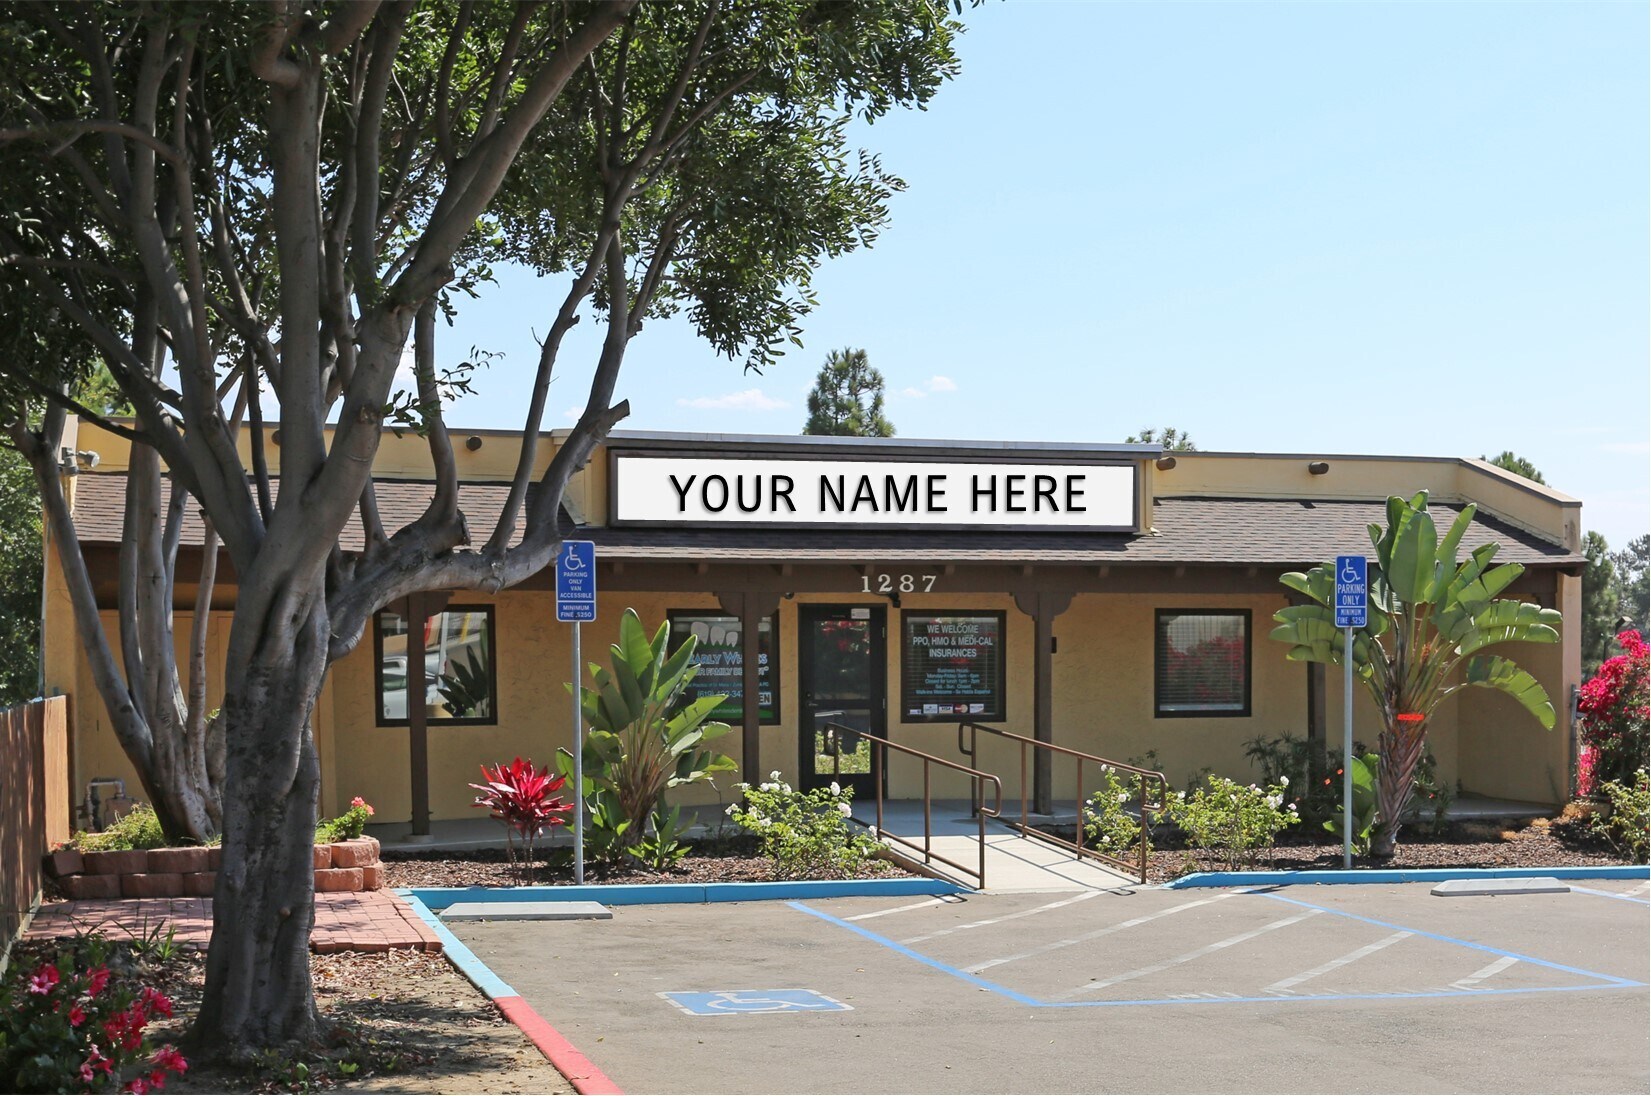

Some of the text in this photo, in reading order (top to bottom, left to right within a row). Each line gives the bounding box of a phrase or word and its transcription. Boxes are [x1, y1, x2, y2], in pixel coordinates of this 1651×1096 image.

[669, 474, 1088, 514] YOUR NAME HERE
[861, 574, 937, 594] 1287
[1338, 584, 1364, 594] PARKING
[1342, 595, 1360, 605] ONLY
[1337, 616, 1349, 624] FINE
[927, 624, 979, 634] WE WELCOME
[912, 636, 993, 647] PPO, HMO & MEDI-CAL
[929, 648, 977, 658] INSURANCES
[706, 667, 733, 676] FAMILY
